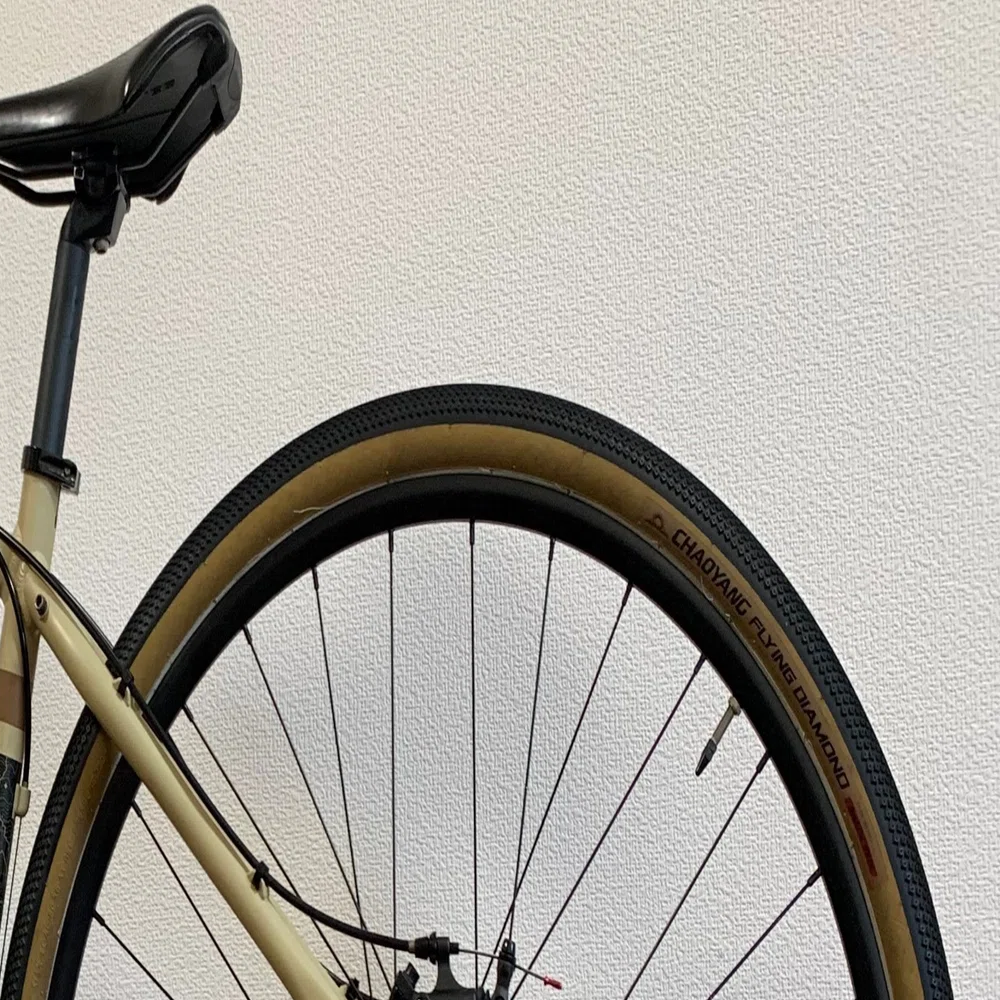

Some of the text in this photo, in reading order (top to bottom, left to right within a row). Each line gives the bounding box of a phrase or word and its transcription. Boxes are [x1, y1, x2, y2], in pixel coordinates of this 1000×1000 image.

[671, 528, 850, 791] CHAOYANG FLYING DIAMOND
